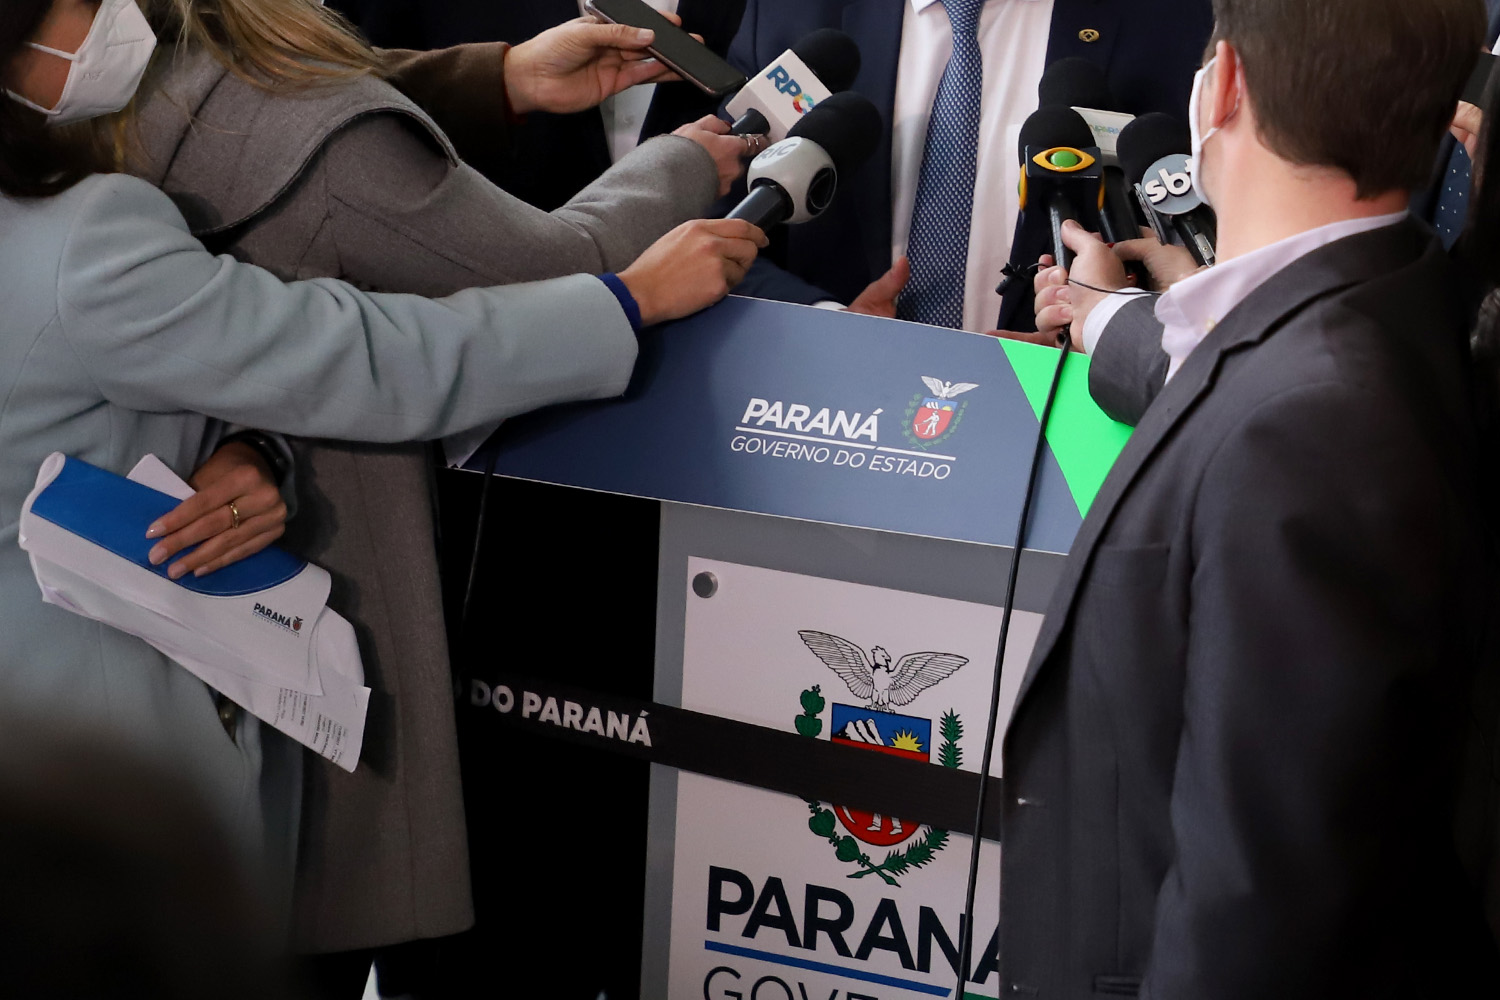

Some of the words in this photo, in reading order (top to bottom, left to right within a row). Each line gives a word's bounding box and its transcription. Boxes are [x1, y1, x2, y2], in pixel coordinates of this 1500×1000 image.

[741, 397, 884, 442] PARANÁ
[730, 435, 830, 463] GOVERNO
[832, 449, 866, 469] DO
[868, 454, 951, 480] ESTADO
[470, 678, 515, 714] DO
[521, 690, 653, 748] PARANÁ
